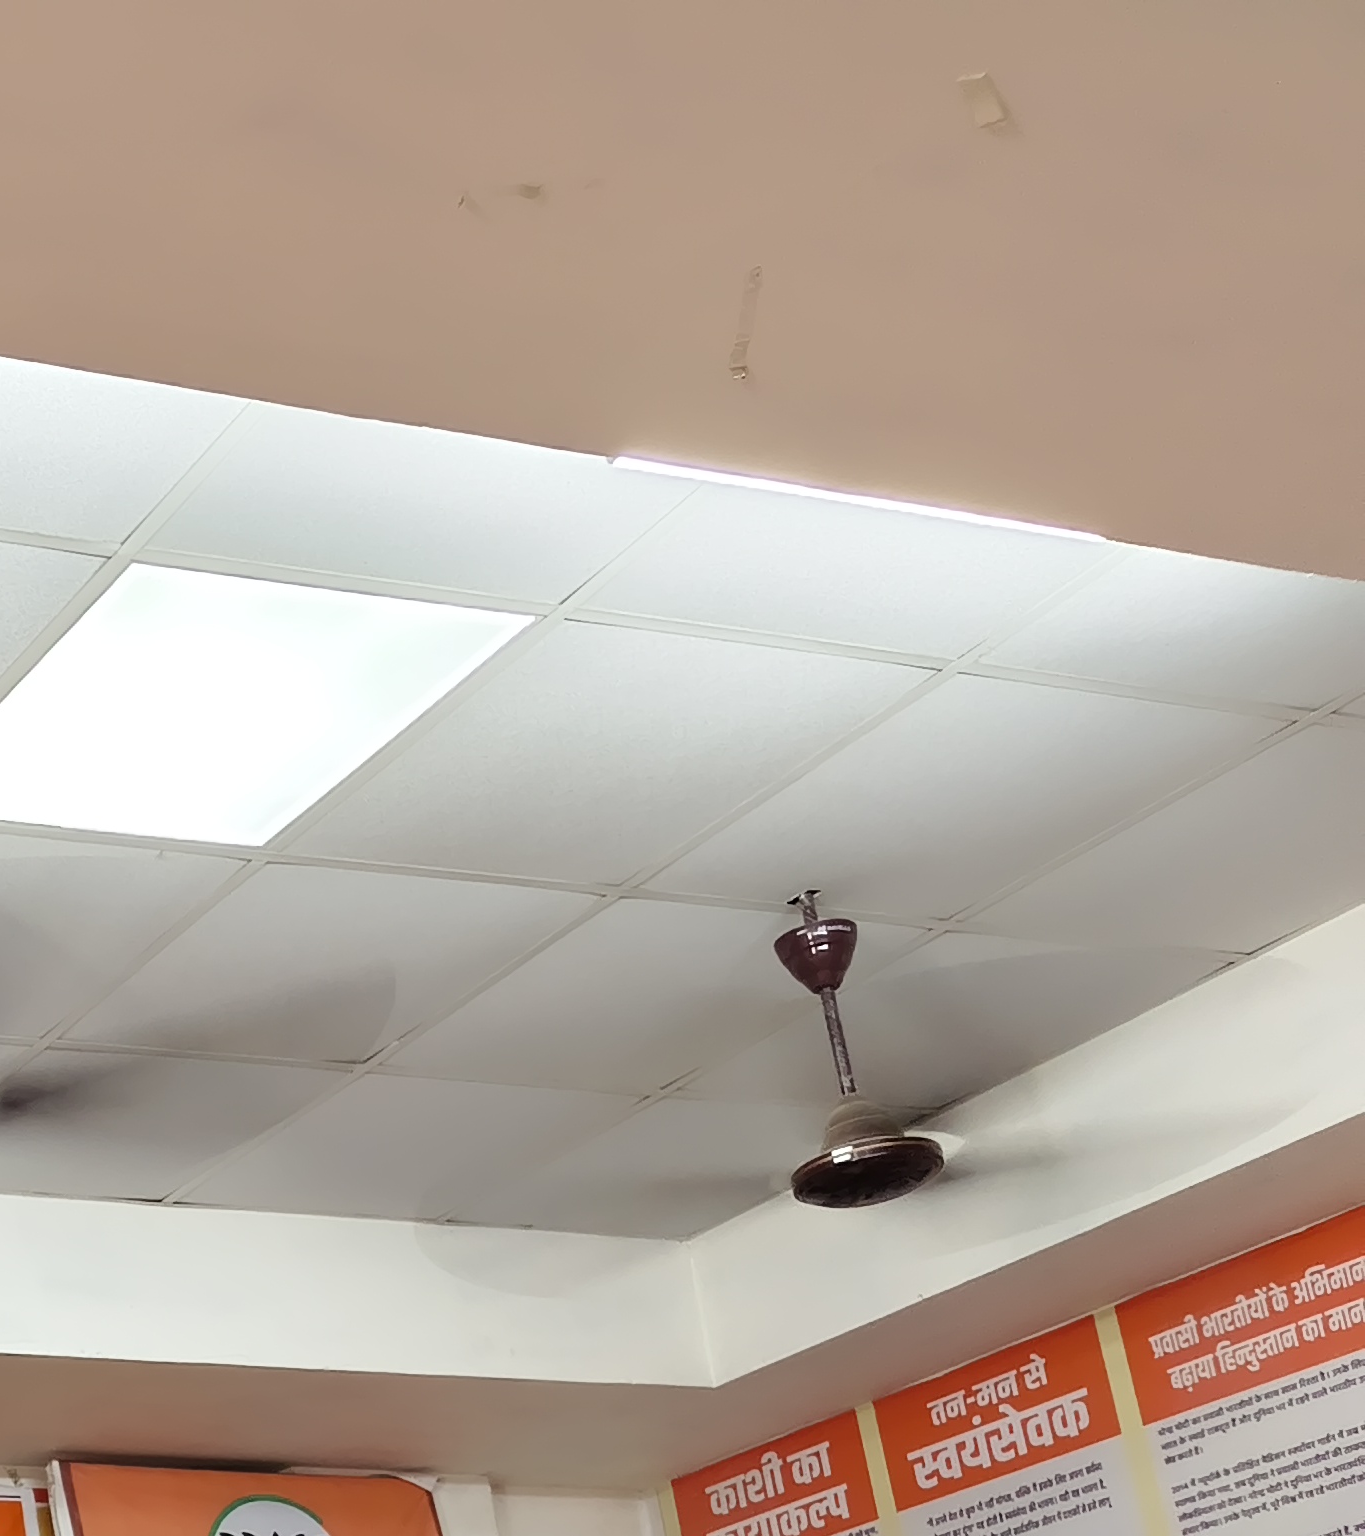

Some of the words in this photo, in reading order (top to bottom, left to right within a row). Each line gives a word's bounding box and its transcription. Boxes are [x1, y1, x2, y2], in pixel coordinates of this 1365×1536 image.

[1148, 1315, 1200, 1358] प्रवासी
[1201, 1287, 1269, 1338] भारतीयों
[1269, 1282, 1289, 1312] के
[1216, 1323, 1299, 1373] हिन्दुस्तान
[1298, 1313, 1326, 1342] का
[927, 1367, 1019, 1427] तन-मन
[1020, 1354, 1048, 1391] से
[907, 1388, 1090, 1490] स्वयंसेवक
[705, 1448, 785, 1517] काशी
[786, 1441, 832, 1488] का
